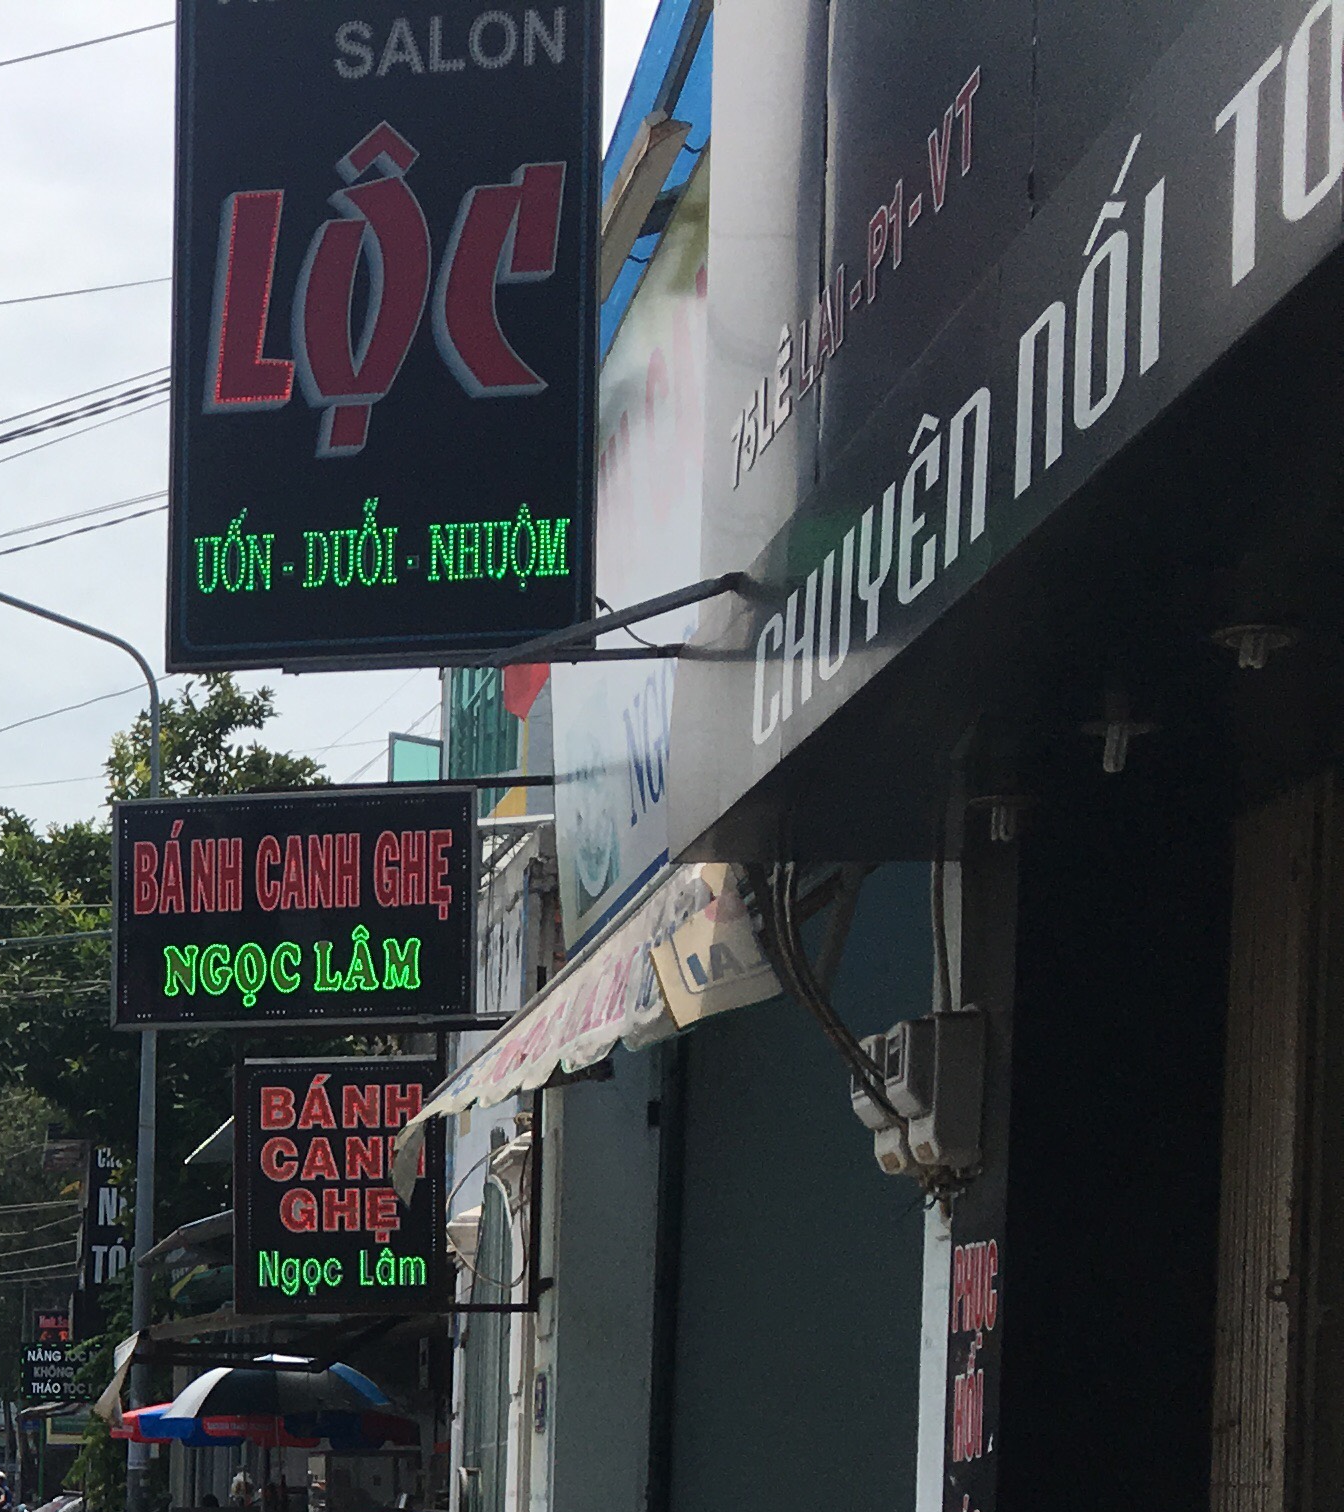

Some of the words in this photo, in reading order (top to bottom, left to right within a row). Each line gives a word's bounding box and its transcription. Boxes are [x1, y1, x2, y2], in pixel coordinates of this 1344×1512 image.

[333, 6, 566, 80] SALON
[201, 119, 567, 458] LỘC
[759, 323, 793, 456] LÊ
[193, 507, 275, 594] UỐN
[427, 502, 571, 592] NHUỘM
[132, 819, 244, 916] BÁNH
[255, 831, 361, 912] CANH
[373, 828, 454, 921] GHẸ
[163, 940, 302, 1008] NGỌC
[313, 924, 422, 993] LÂM
[260, 1073, 423, 1131] BÁNH
[279, 1187, 401, 1244] GHẸ
[259, 1250, 345, 1296] Ngọc
[359, 1247, 427, 1287] Lâm
